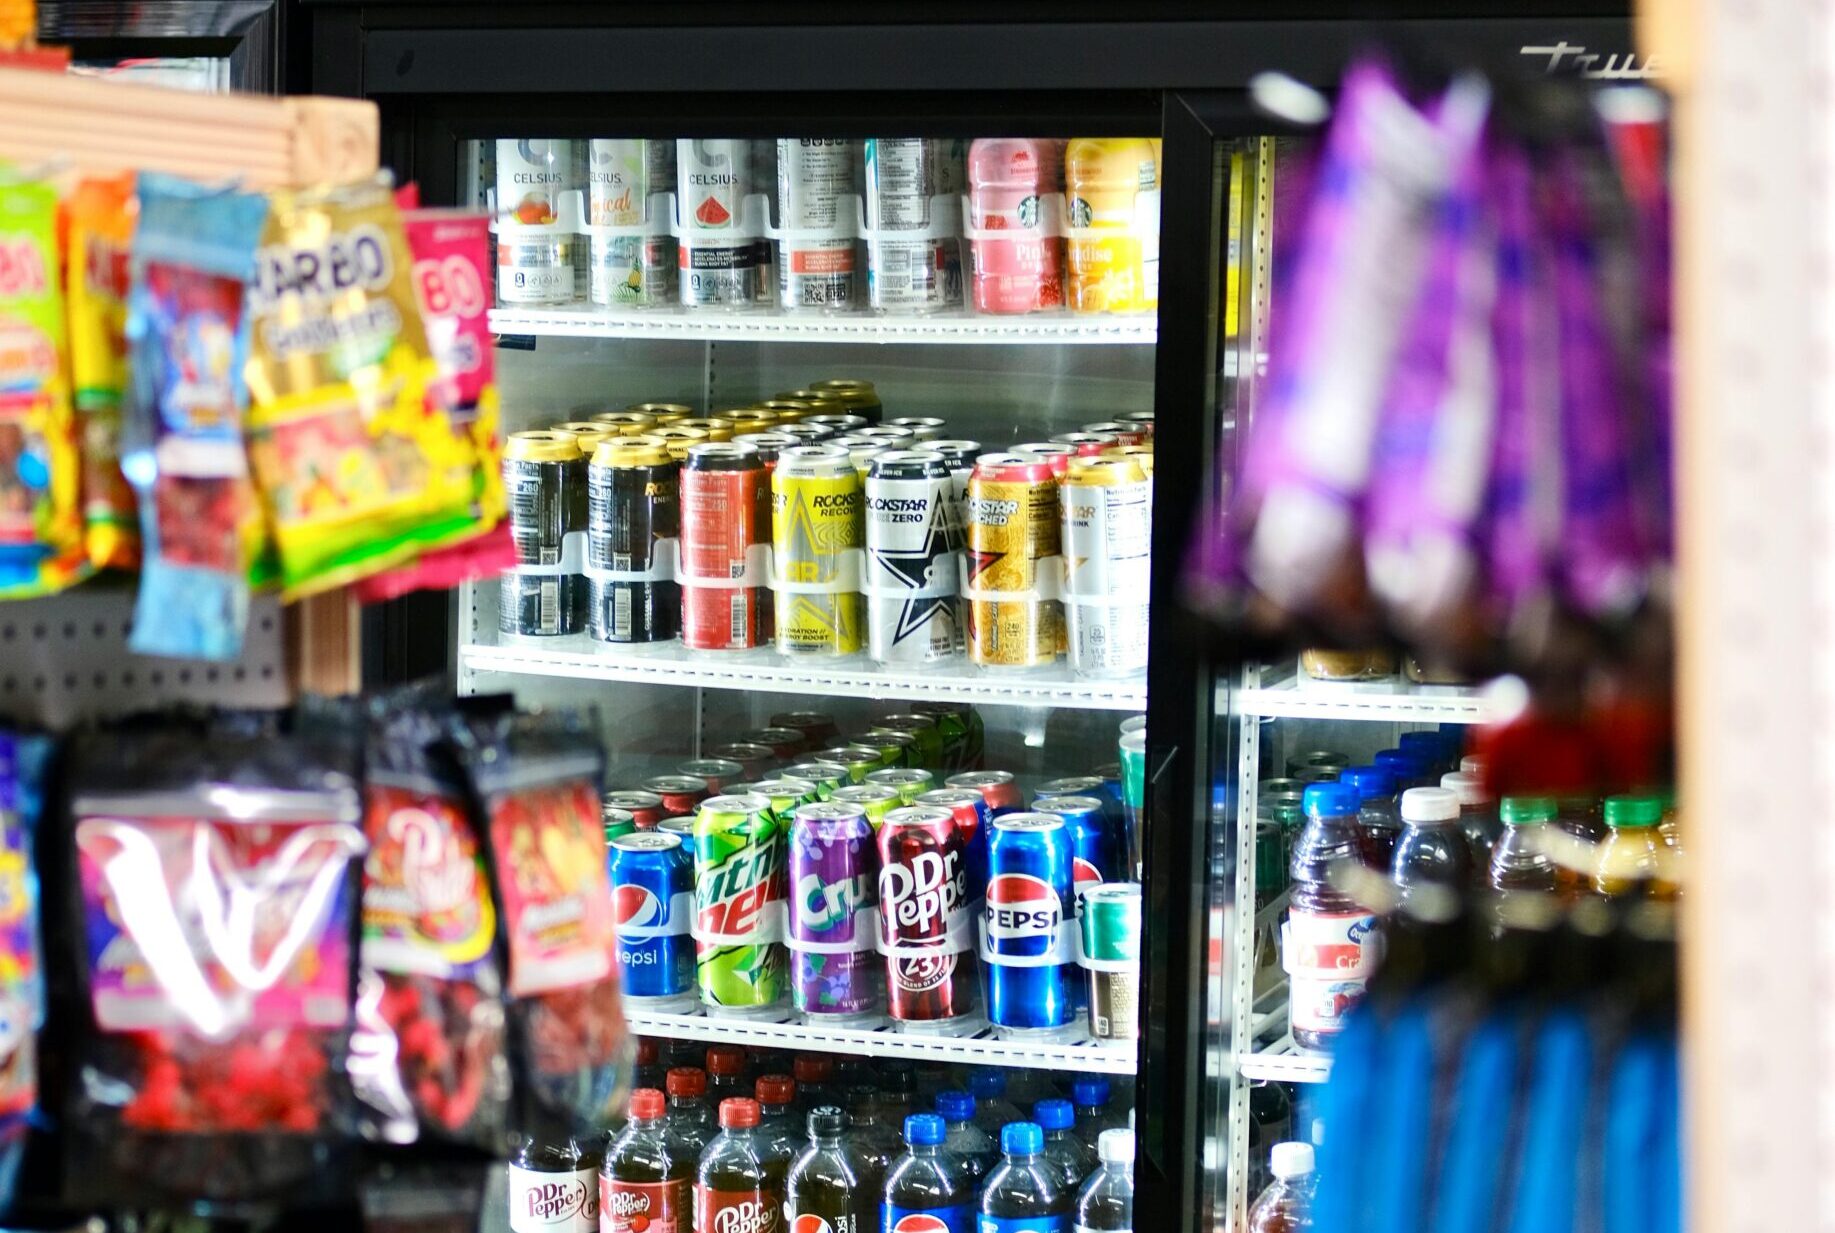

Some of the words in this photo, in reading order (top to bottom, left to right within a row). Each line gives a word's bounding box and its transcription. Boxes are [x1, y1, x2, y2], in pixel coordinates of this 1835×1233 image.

[513, 172, 561, 184] CELSIUS
[689, 173, 738, 185] CELSIUS
[813, 493, 856, 508] ROCKS
[891, 513, 923, 523] ZERO
[911, 851, 958, 896] Dr
[798, 872, 872, 930] Cru
[879, 863, 966, 933] Peppe
[986, 905, 1058, 929] PEPSI
[905, 952, 934, 977] 23
[527, 1186, 583, 1219] Pepper
[543, 1183, 567, 1201] Dr
[622, 1191, 636, 1210] Dr
[609, 1193, 647, 1216] Pepper
[739, 1201, 764, 1222] Dr
